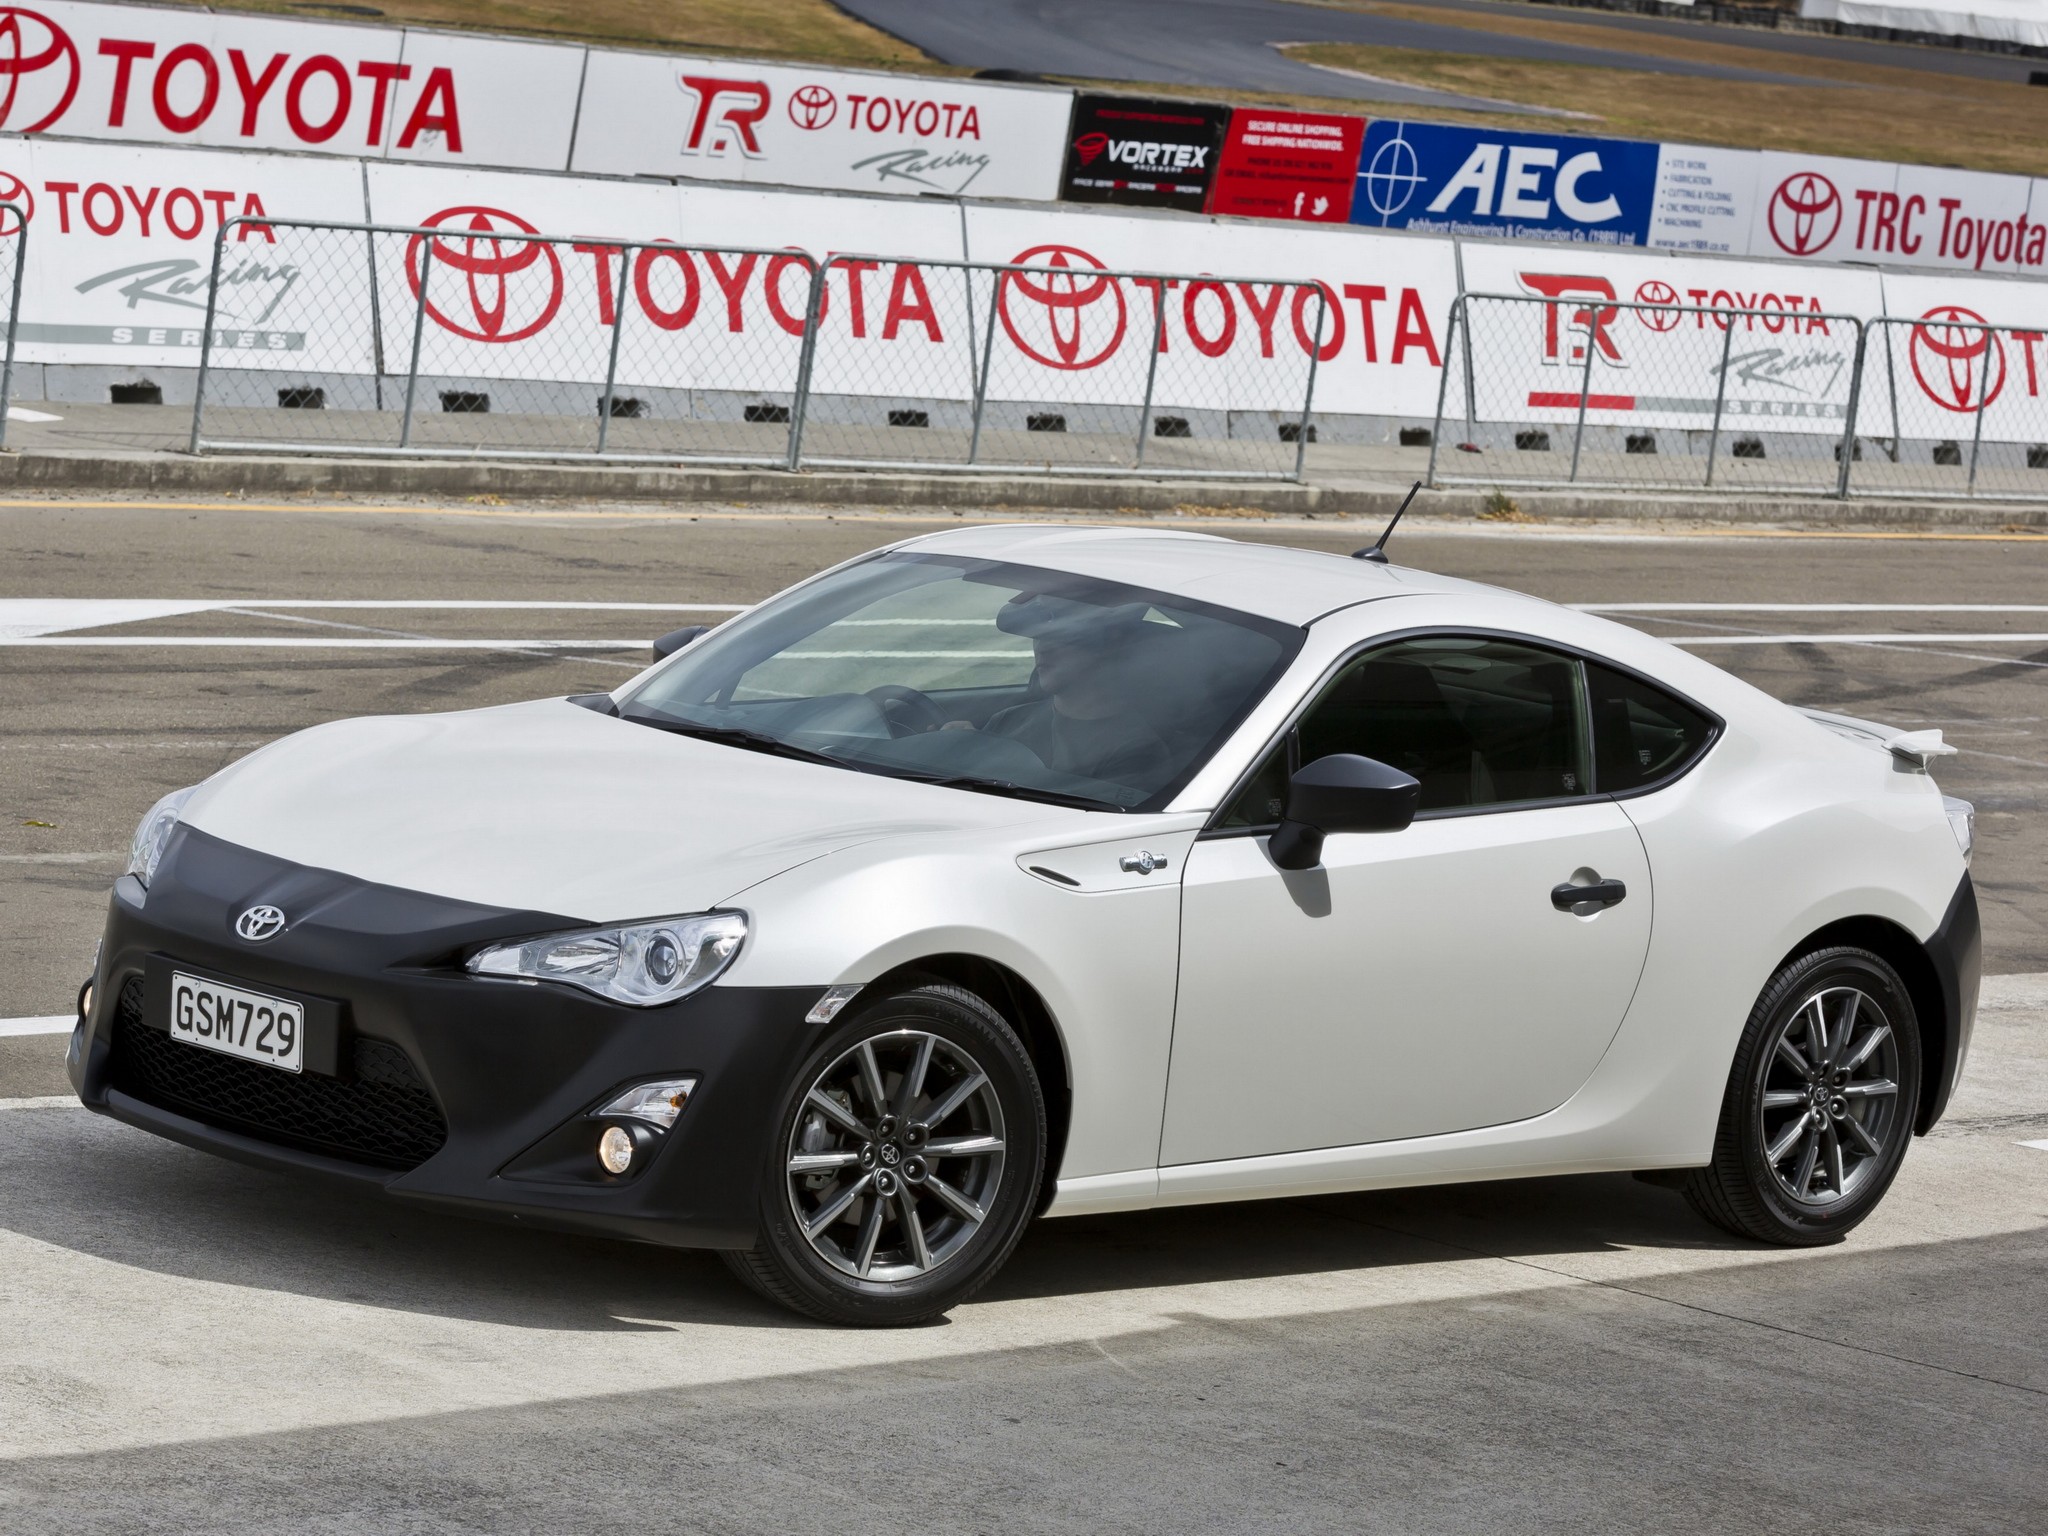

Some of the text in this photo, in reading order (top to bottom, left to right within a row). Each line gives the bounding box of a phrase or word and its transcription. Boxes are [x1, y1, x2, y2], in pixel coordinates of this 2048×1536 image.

[98, 38, 462, 152] TOYOTA
[847, 95, 981, 140] TOYOTA
[851, 149, 992, 193] Racing
[1108, 139, 1210, 168] VORTEX
[1425, 143, 1623, 223] AEC
[45, 181, 276, 244] TOYOTA
[1855, 189, 2047, 271] TRC Toyota
[572, 235, 944, 343] TOYOTA
[1687, 289, 1830, 336] TOYOTA
[112, 327, 290, 350] SERIES
[1133, 271, 1443, 367] TOYOTA
[1710, 348, 1847, 398] Racing
[1726, 400, 1840, 419] SERIES
[177, 985, 296, 1058] GSM729
